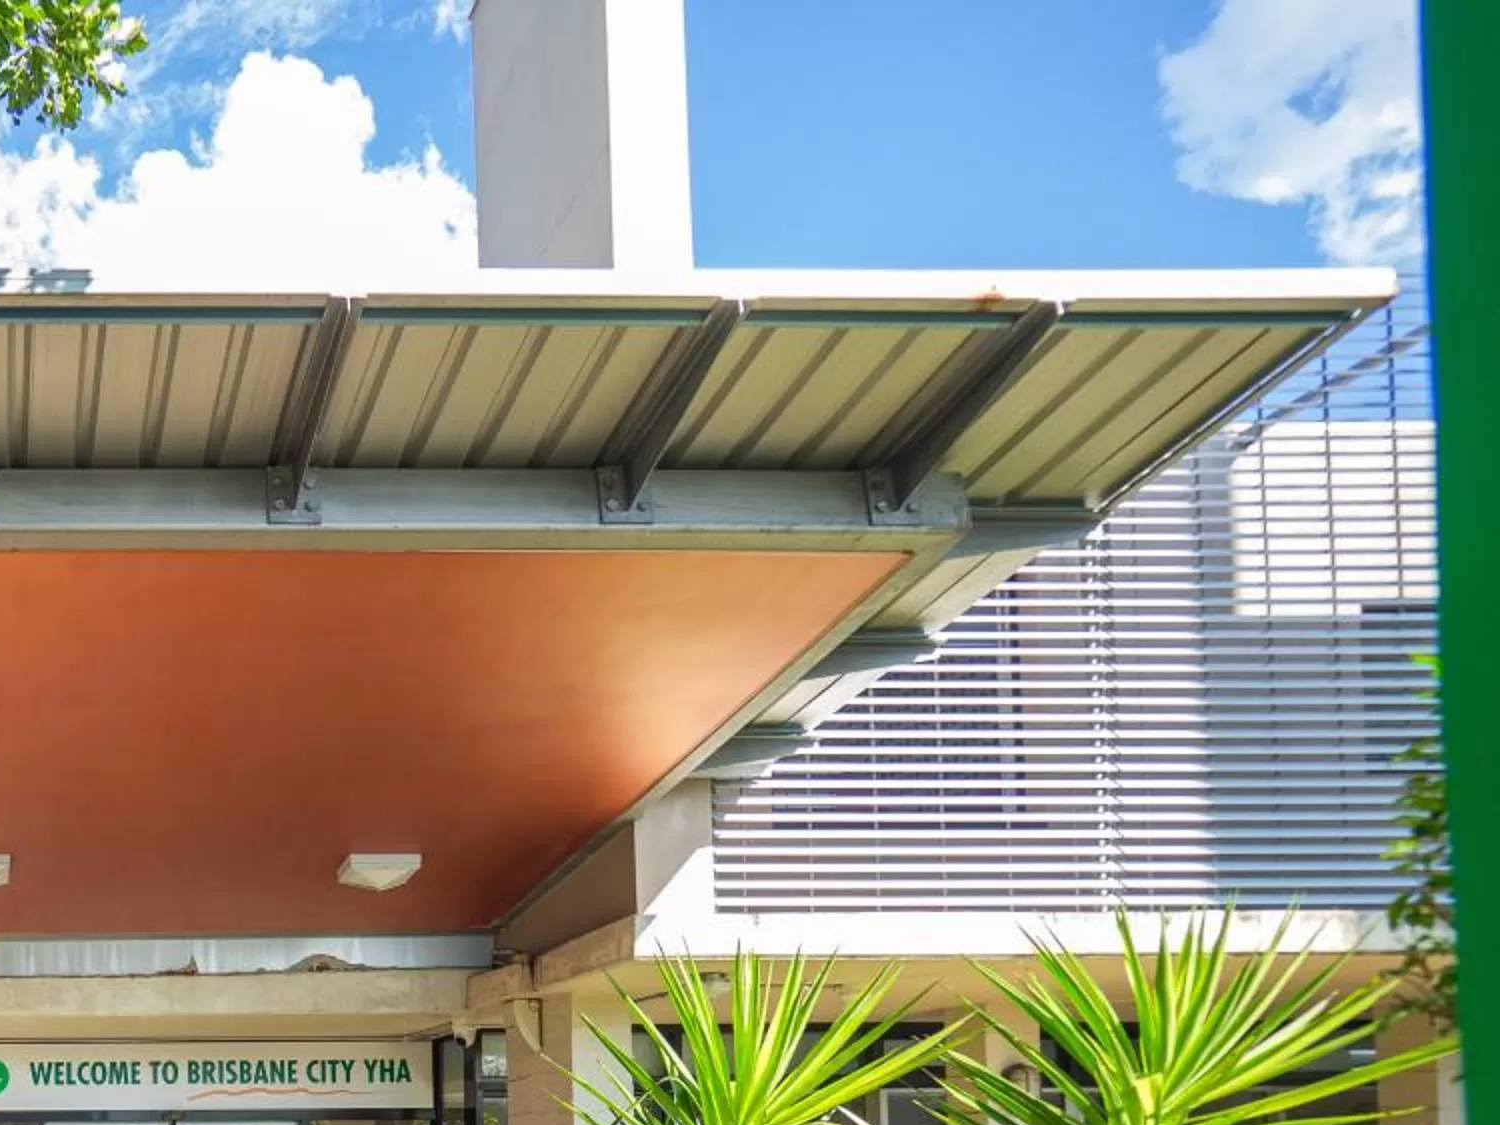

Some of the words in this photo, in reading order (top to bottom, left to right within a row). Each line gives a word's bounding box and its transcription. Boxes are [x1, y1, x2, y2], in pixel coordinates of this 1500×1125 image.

[30, 1061, 141, 1085] WELCOME
[149, 1061, 179, 1084] TO
[187, 1060, 298, 1084] BRISBANE
[306, 1060, 356, 1083] CITY
[364, 1059, 412, 1083] YHA
